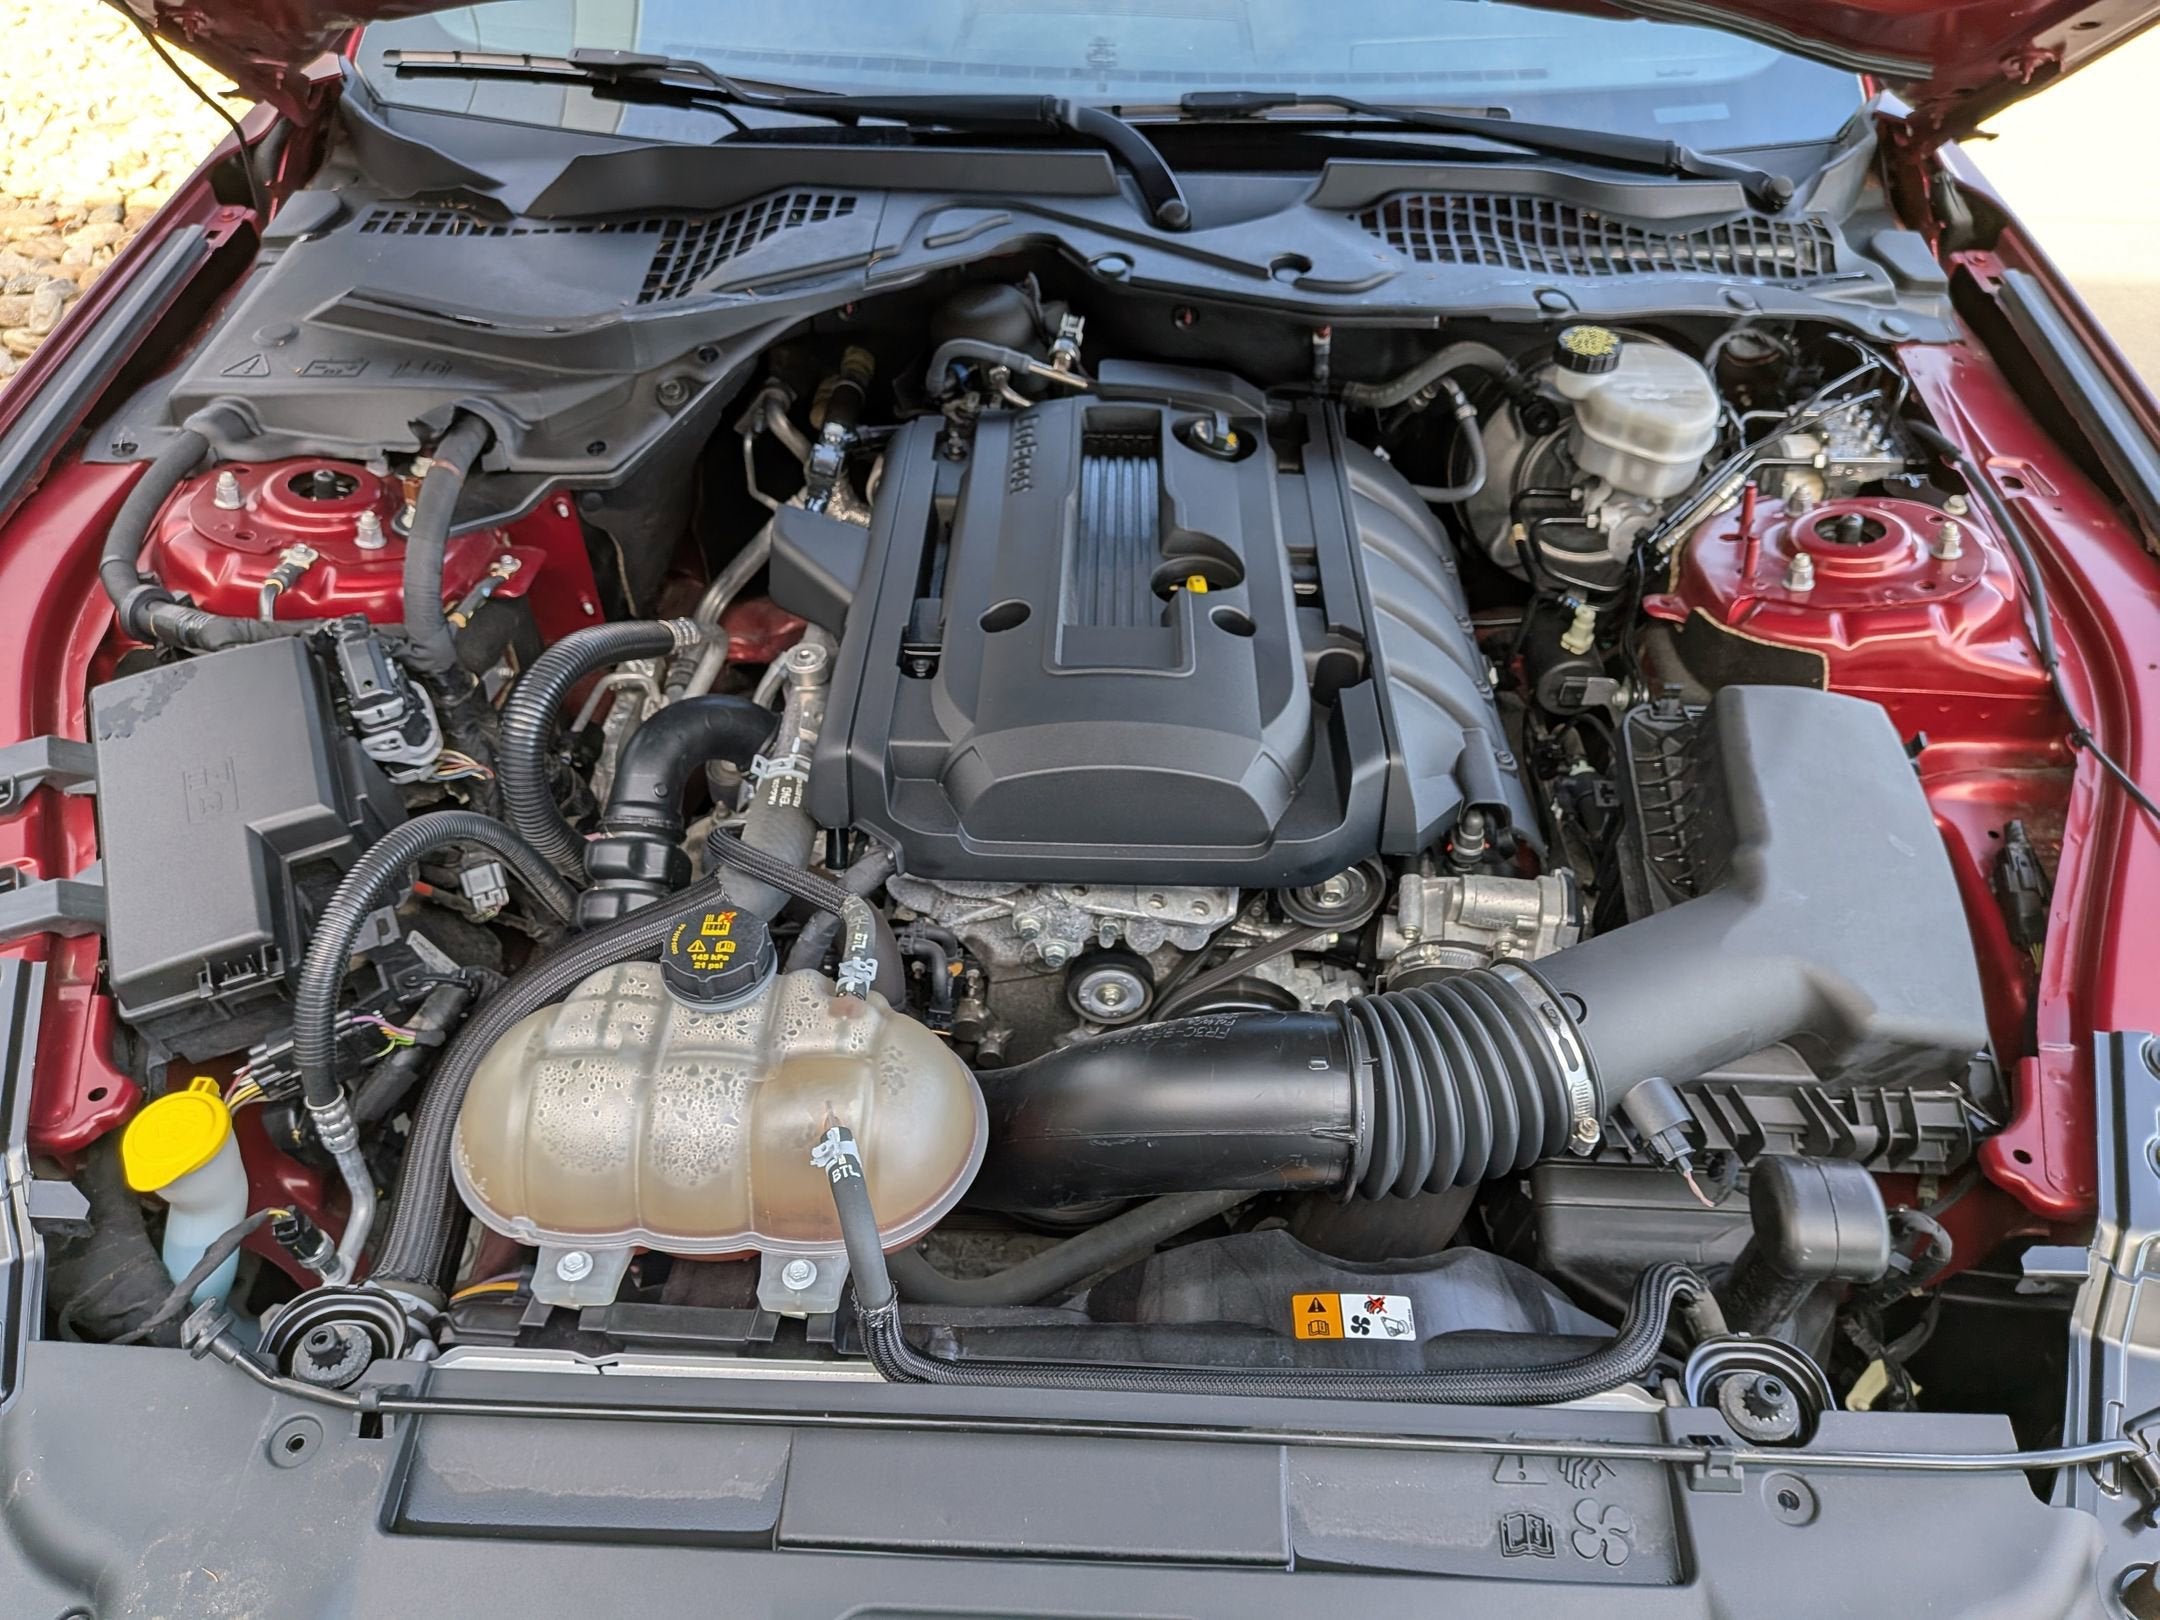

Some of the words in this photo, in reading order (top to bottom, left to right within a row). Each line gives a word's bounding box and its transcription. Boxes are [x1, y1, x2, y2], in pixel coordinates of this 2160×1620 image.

[690, 953, 709, 962] 145
[710, 953, 729, 962] kPa
[693, 961, 706, 969] 21
[707, 961, 724, 970] psi
[831, 1164, 861, 1184] BTL
